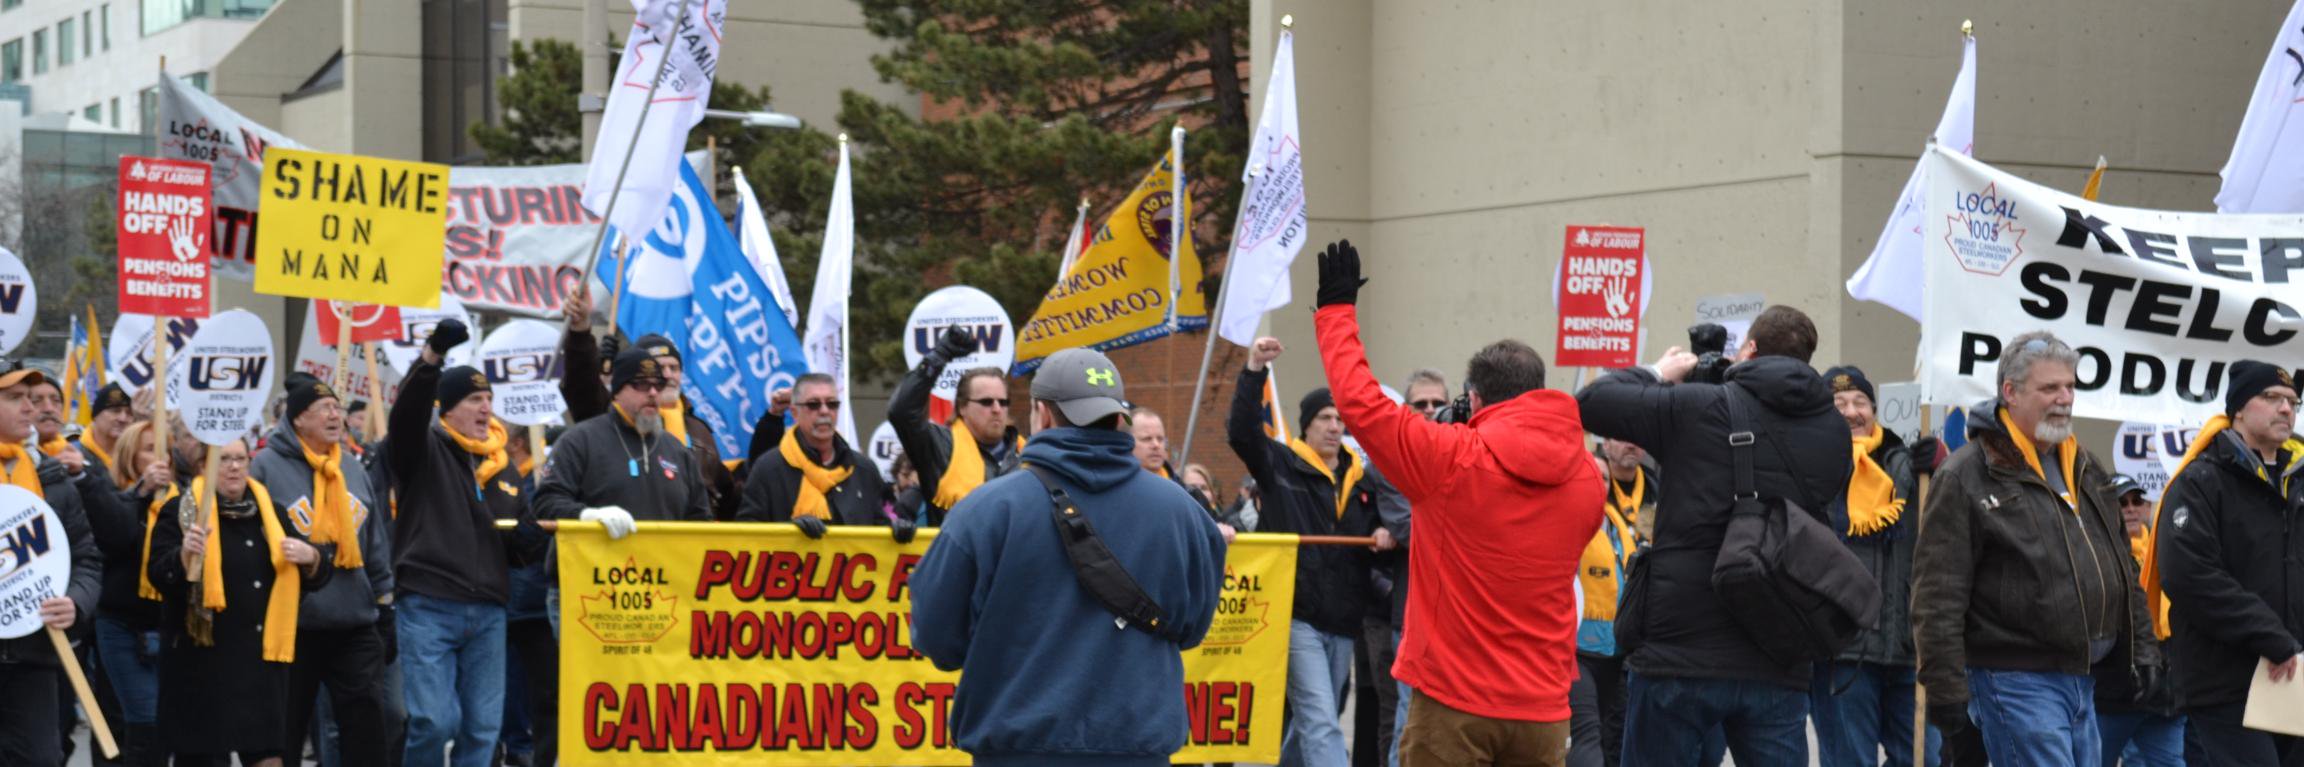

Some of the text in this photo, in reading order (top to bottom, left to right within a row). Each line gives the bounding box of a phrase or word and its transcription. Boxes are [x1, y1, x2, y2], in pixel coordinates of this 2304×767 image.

[170, 121, 234, 145] LOCAL
[181, 142, 218, 162] 1005
[274, 158, 440, 213] SHAME
[124, 191, 204, 216] HANDS
[1956, 190, 2018, 220] LOCAL
[124, 213, 169, 235] OFF
[321, 214, 372, 245] ON
[1969, 219, 2000, 242] 1005
[2055, 205, 2304, 284] KEEP
[124, 258, 205, 278] PENSIONS
[281, 247, 389, 285] MANA
[1568, 257, 1637, 277] HANDS
[126, 279, 203, 299] BENEFITS
[1567, 276, 1604, 295] OFF
[1563, 316, 1634, 333] PENSIONS
[1563, 336, 1630, 352] BENEFITS
[188, 355, 269, 392] USW
[503, 393, 557, 406] STAND UP
[504, 403, 558, 416] FOR STEEL
[198, 407, 249, 419] STAND UP
[194, 419, 247, 431] FOR STEEL
[33, 574, 52, 593] UP
[592, 566, 669, 586] LOCAL
[694, 550, 878, 602] PUBLIC
[609, 591, 653, 610] 1005
[583, 682, 880, 752] CANADIANS
